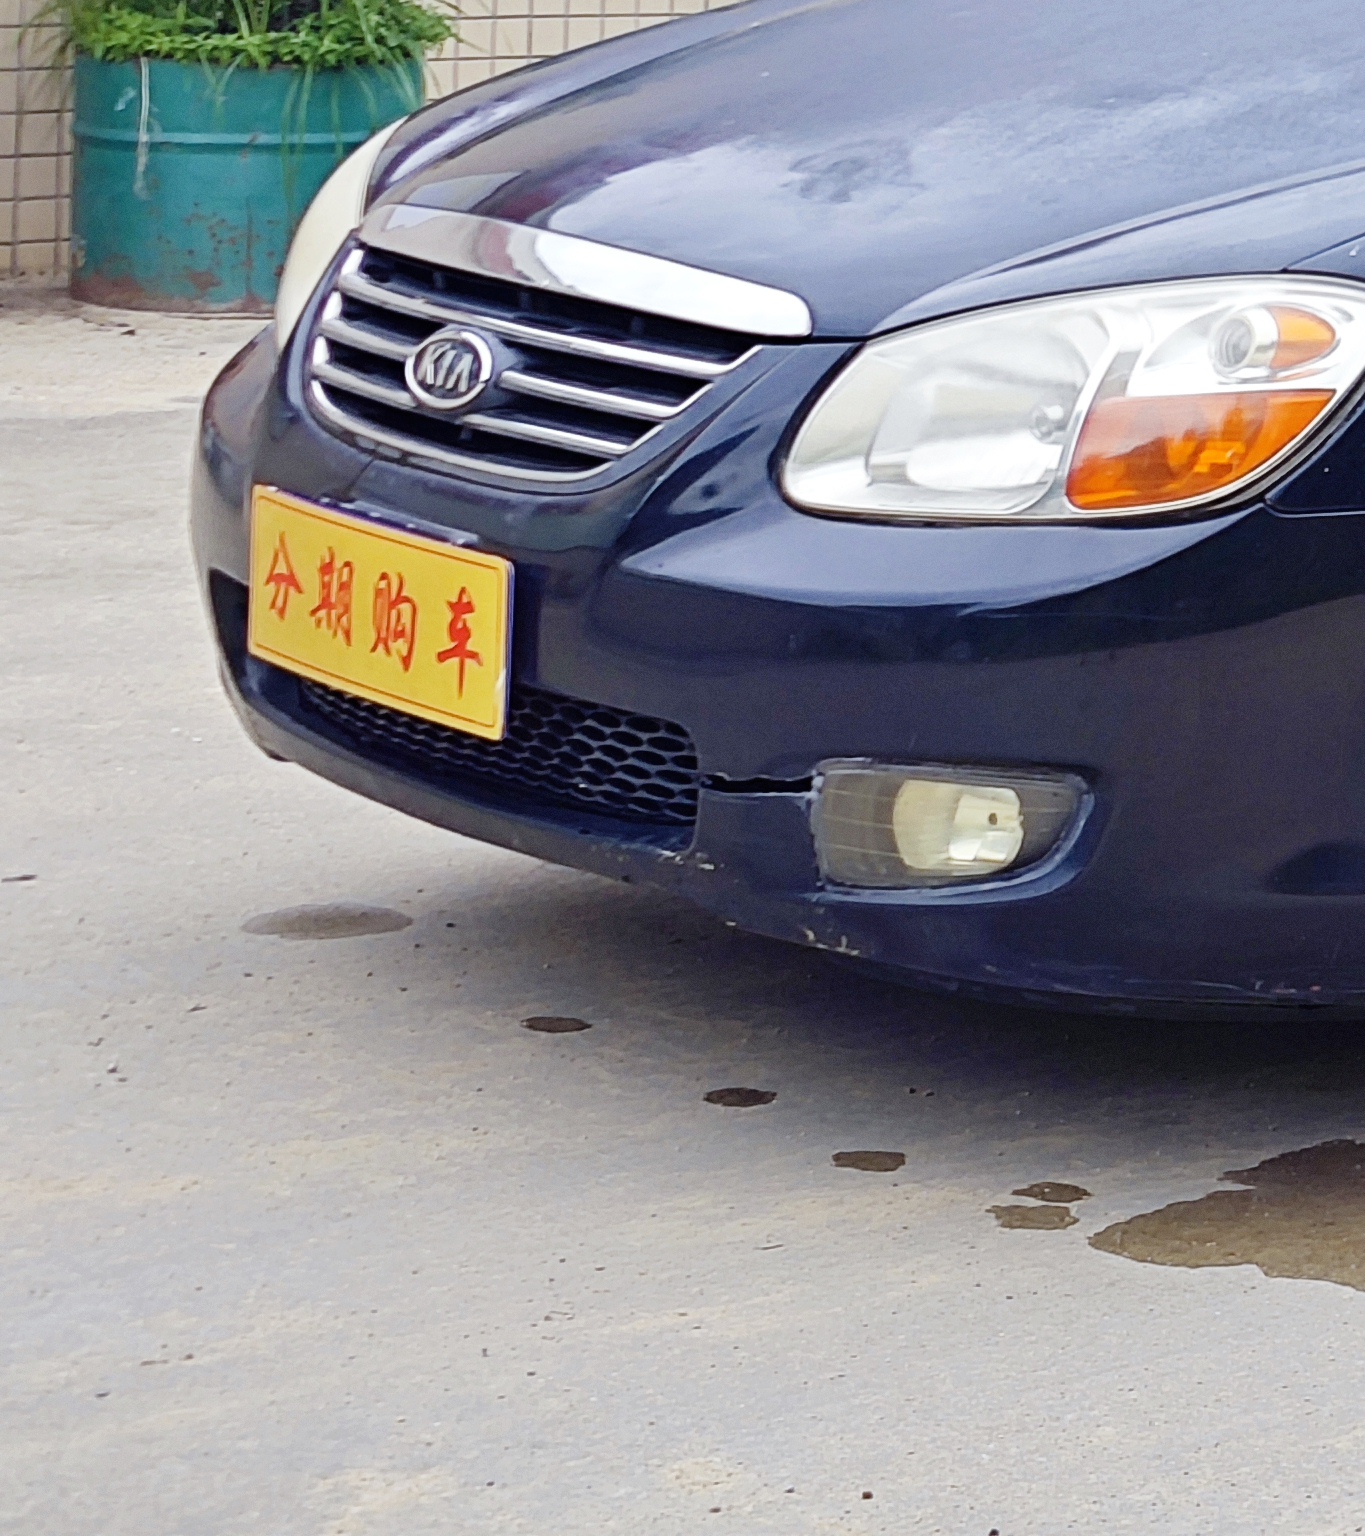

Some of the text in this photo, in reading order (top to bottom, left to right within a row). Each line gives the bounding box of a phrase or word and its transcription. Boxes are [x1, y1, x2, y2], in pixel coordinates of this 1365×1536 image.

[417, 342, 475, 393] KIA
[264, 530, 484, 700] 分期购车
